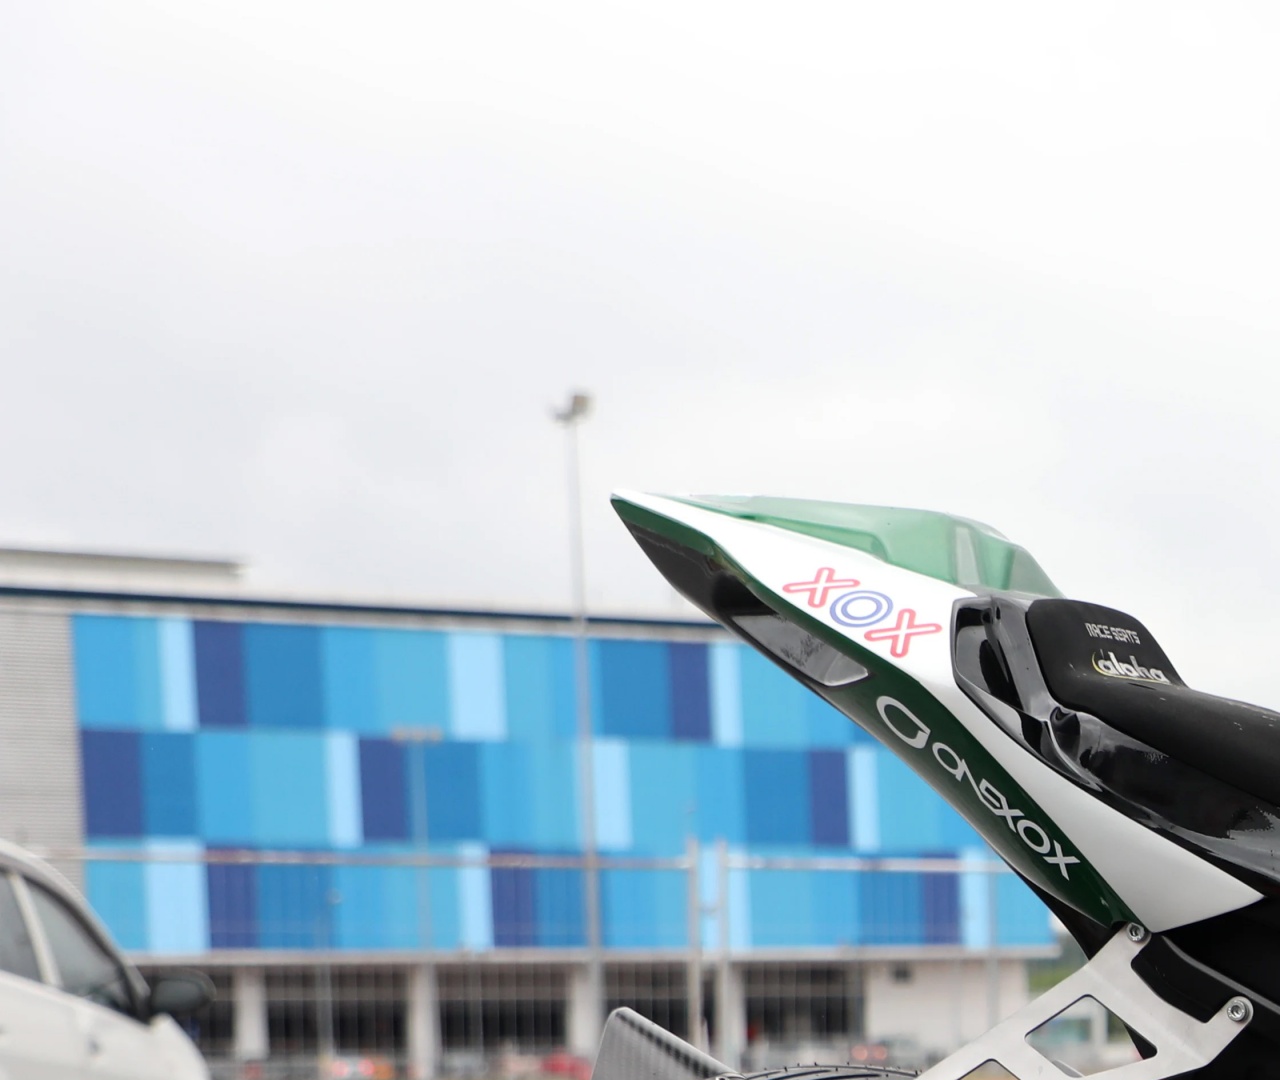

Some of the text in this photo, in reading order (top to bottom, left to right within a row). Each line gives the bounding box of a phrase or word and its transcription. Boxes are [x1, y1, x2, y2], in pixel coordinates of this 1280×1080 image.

[783, 567, 942, 658] XOX
[1084, 622, 1140, 645] RACE SEATS
[1097, 651, 1171, 686] alpha
[932, 741, 1081, 881] ONEXOX
